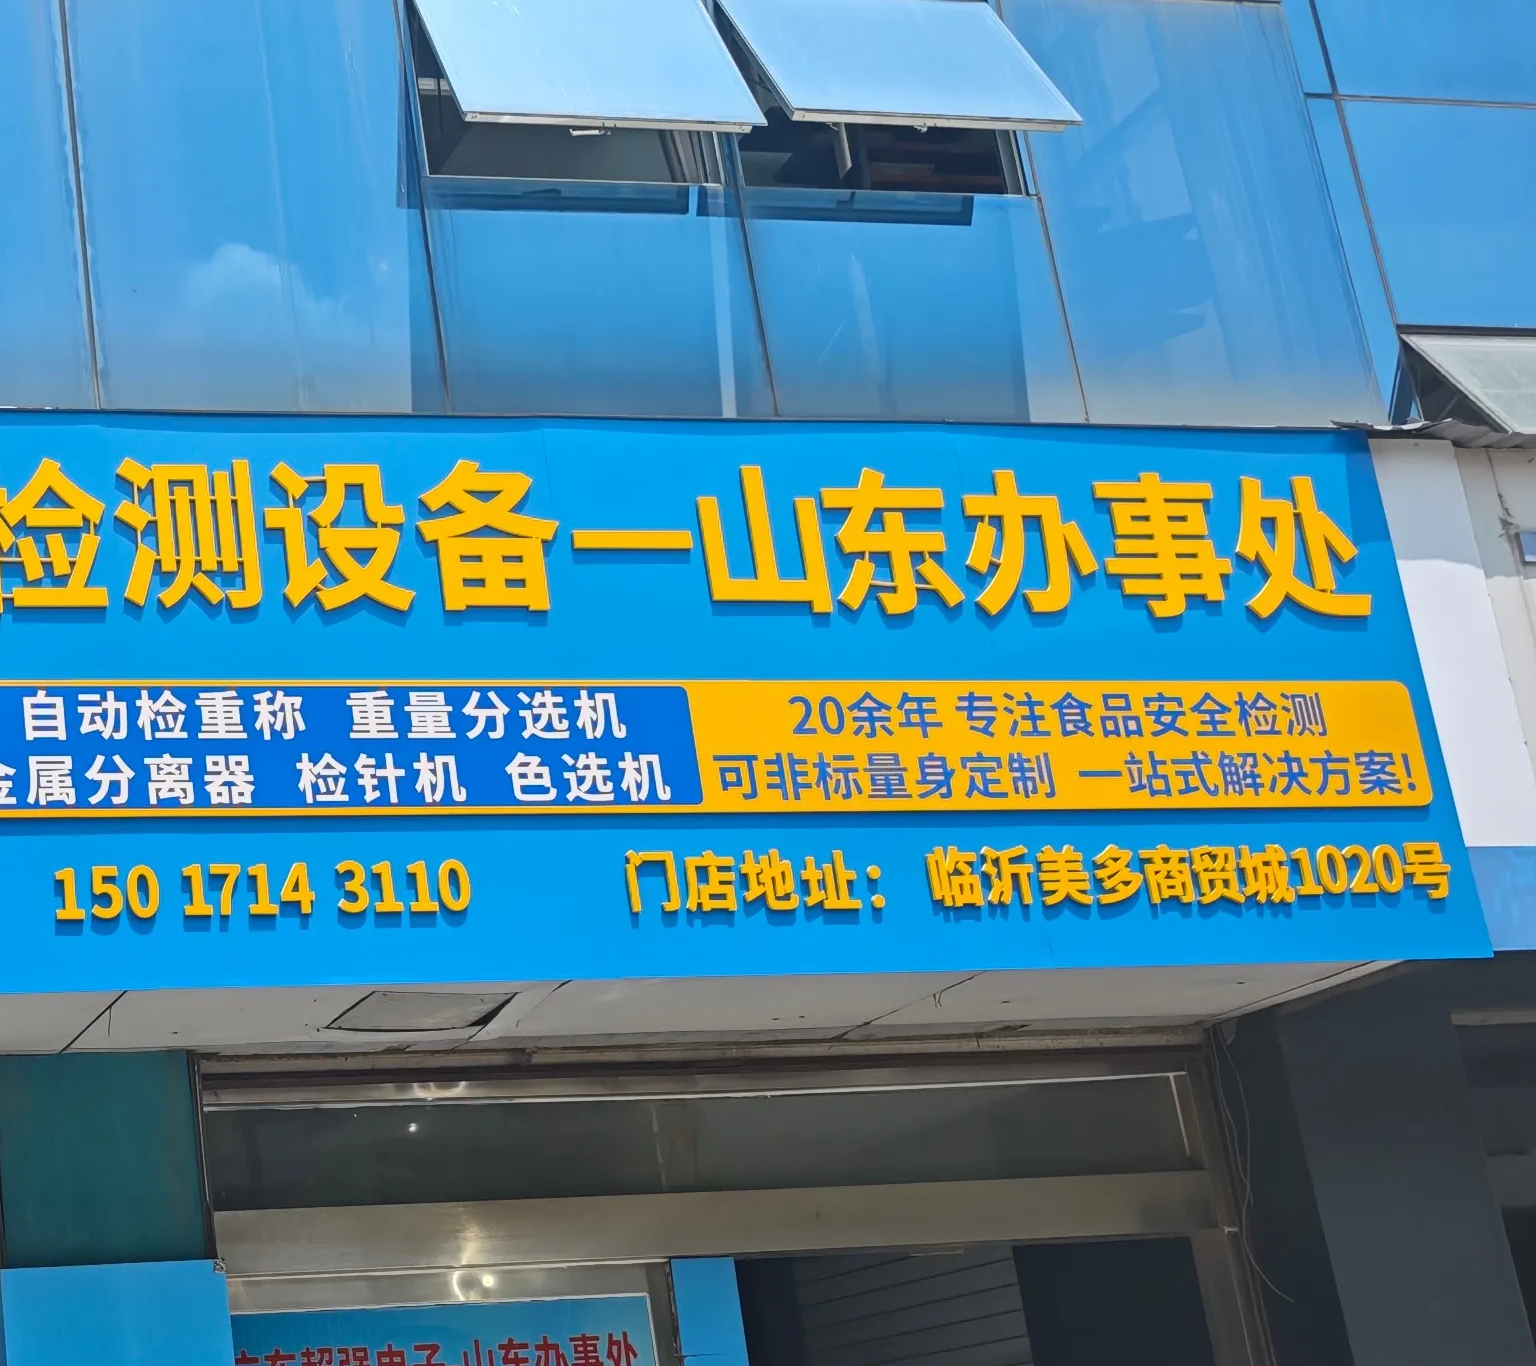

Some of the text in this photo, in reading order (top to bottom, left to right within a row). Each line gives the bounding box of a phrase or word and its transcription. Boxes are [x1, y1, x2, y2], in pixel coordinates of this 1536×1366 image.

[22, 689, 306, 742] 自动检重称
[346, 689, 626, 740] 重量分选机
[787, 690, 1329, 739] 20余年 专注食品安全检测
[296, 752, 467, 806] 检针机
[505, 751, 671, 804] 色选机
[712, 752, 1057, 801] 可非标量身定制
[55, 864, 160, 921] 150
[183, 862, 315, 917] 1714
[337, 859, 470, 914] 3110
[925, 840, 1452, 909] 临沂美多商贸城1020号
